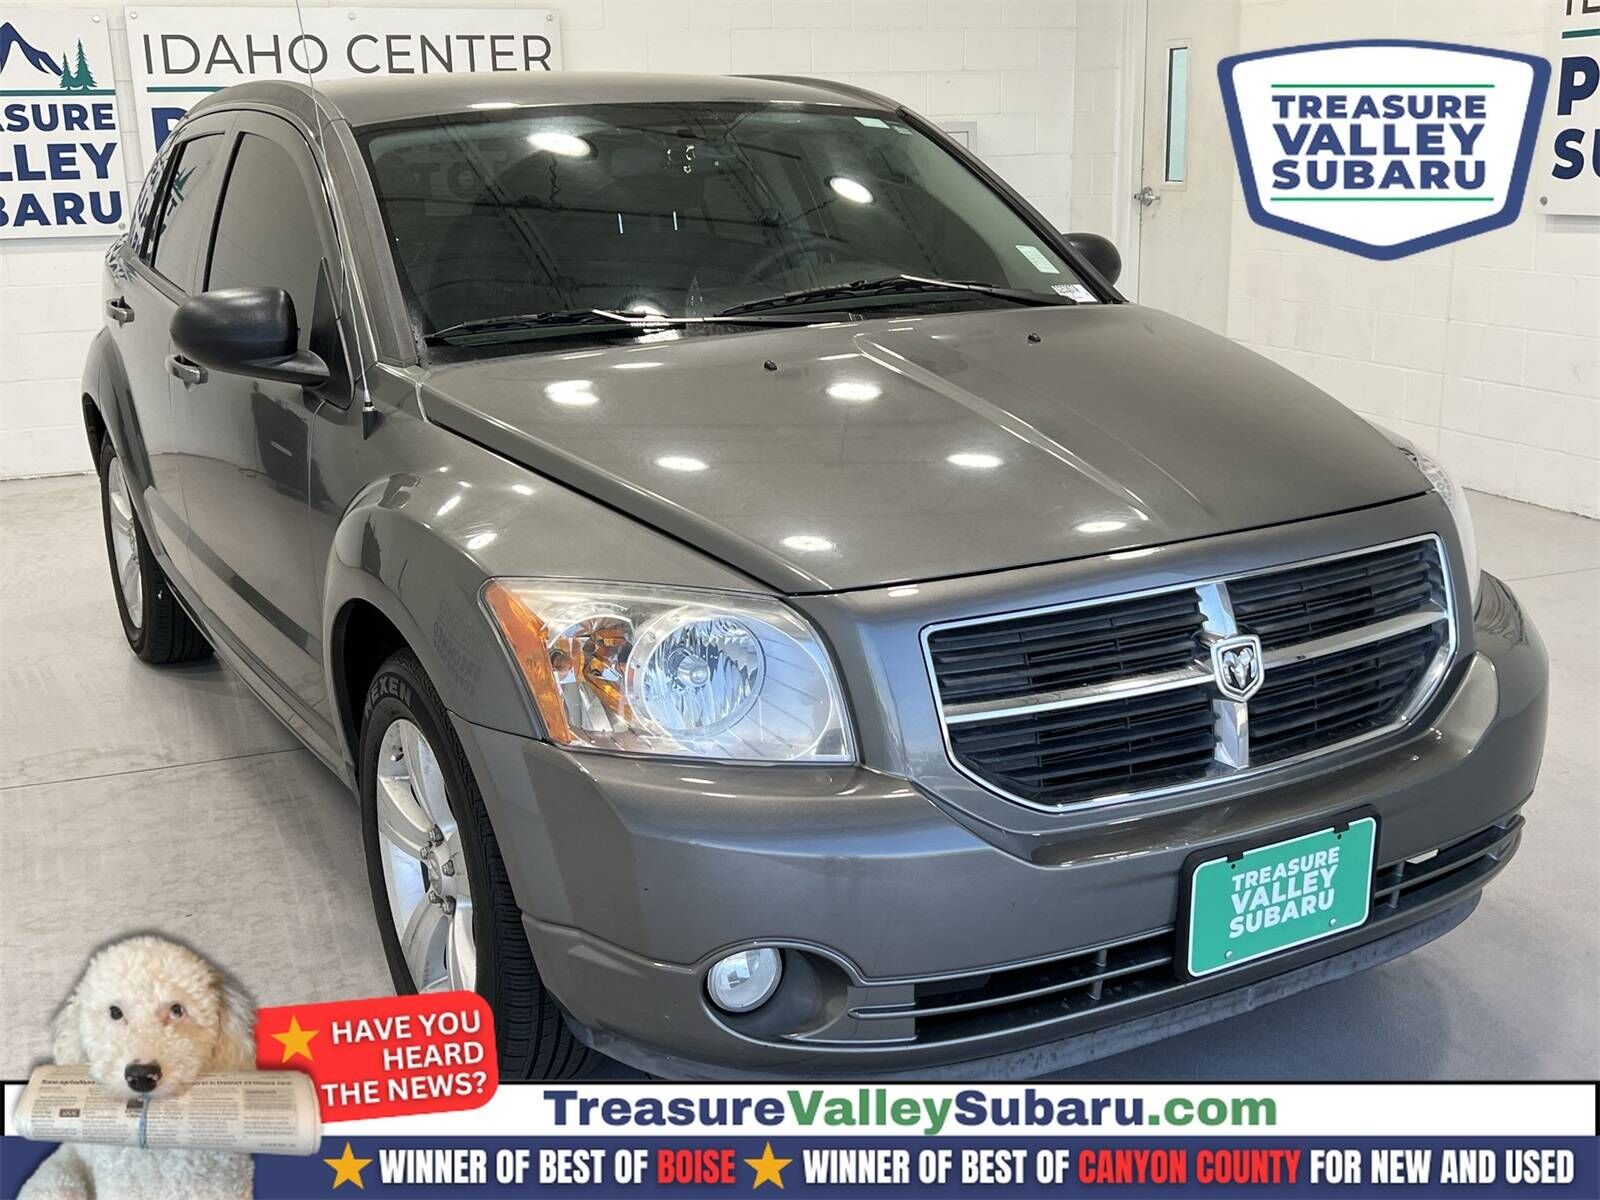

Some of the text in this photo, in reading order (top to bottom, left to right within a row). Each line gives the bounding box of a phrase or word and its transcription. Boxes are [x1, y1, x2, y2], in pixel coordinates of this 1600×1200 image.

[144, 34, 552, 75] IDAHO CENTER
[0, 103, 116, 132] SURE
[1230, 864, 1338, 915] VALLEY
[1231, 846, 1340, 892] TREASURE
[1228, 888, 1335, 939] SUBARU
